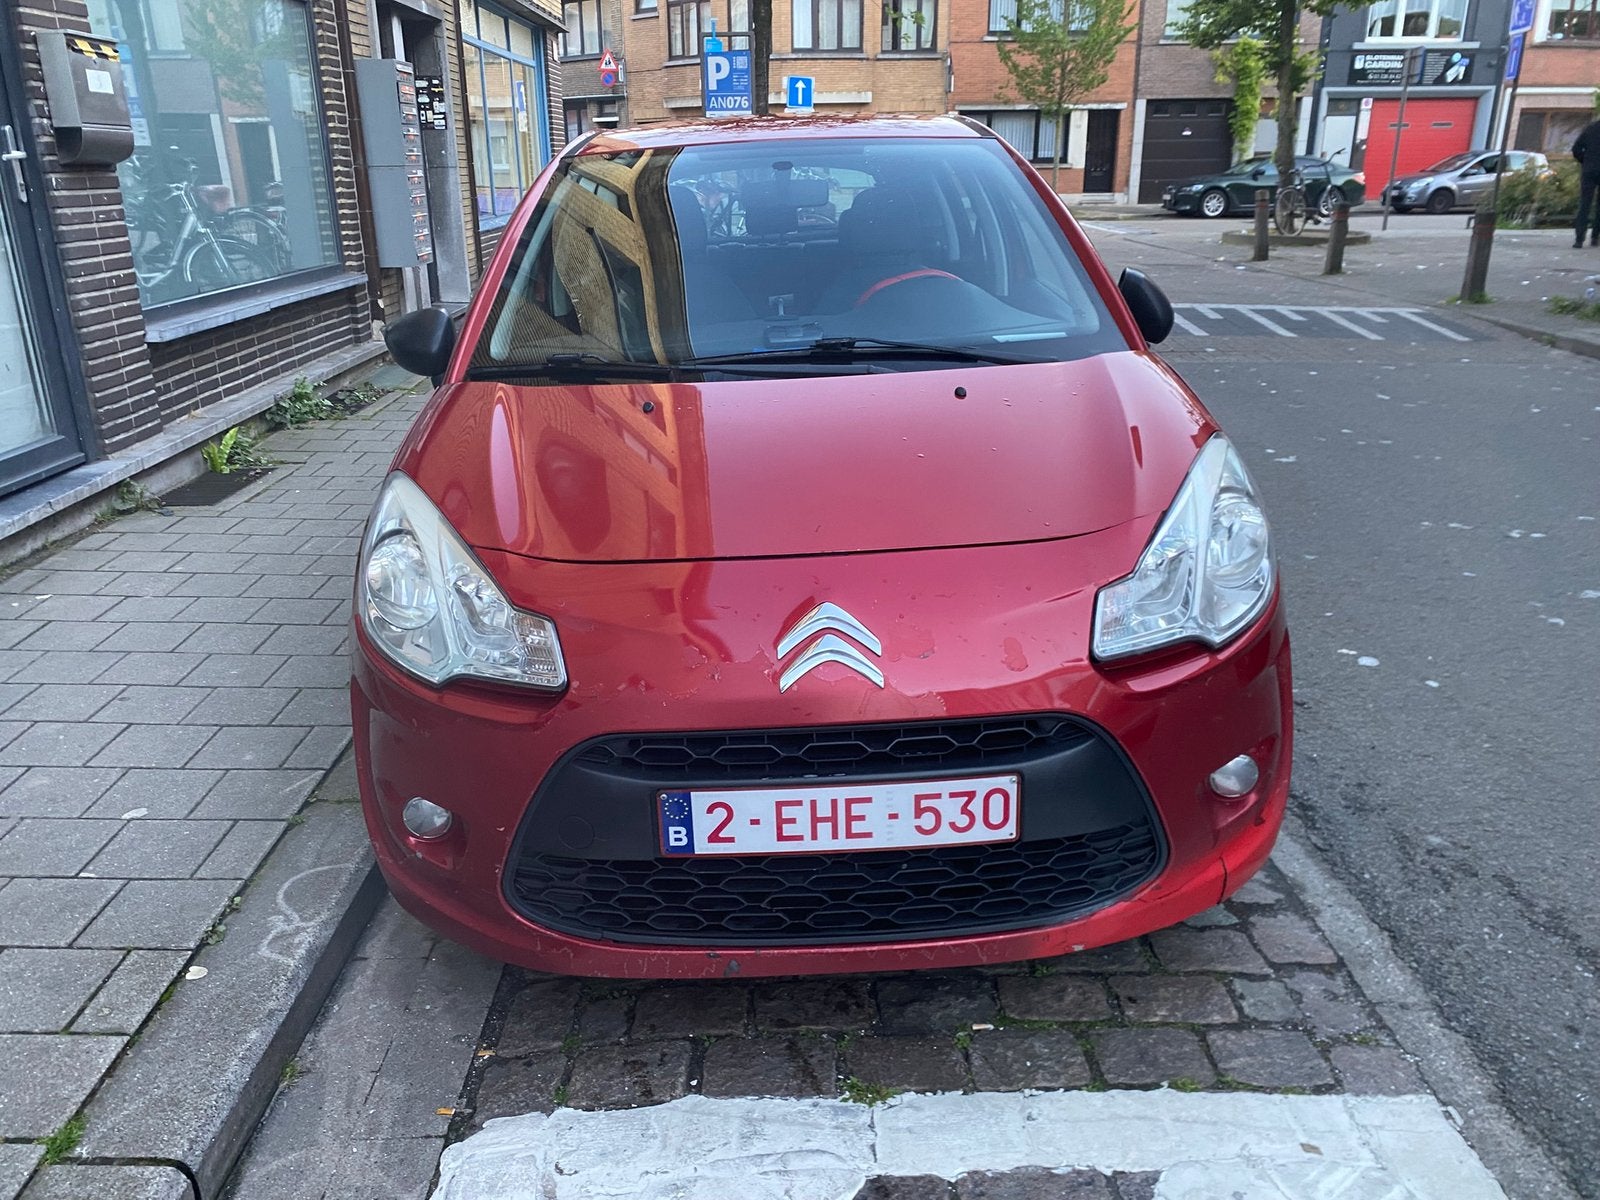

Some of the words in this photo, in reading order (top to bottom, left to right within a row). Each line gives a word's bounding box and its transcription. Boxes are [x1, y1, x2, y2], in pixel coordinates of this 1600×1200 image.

[707, 56, 730, 90] P
[709, 96, 749, 109] AN076
[668, 826, 688, 847] B
